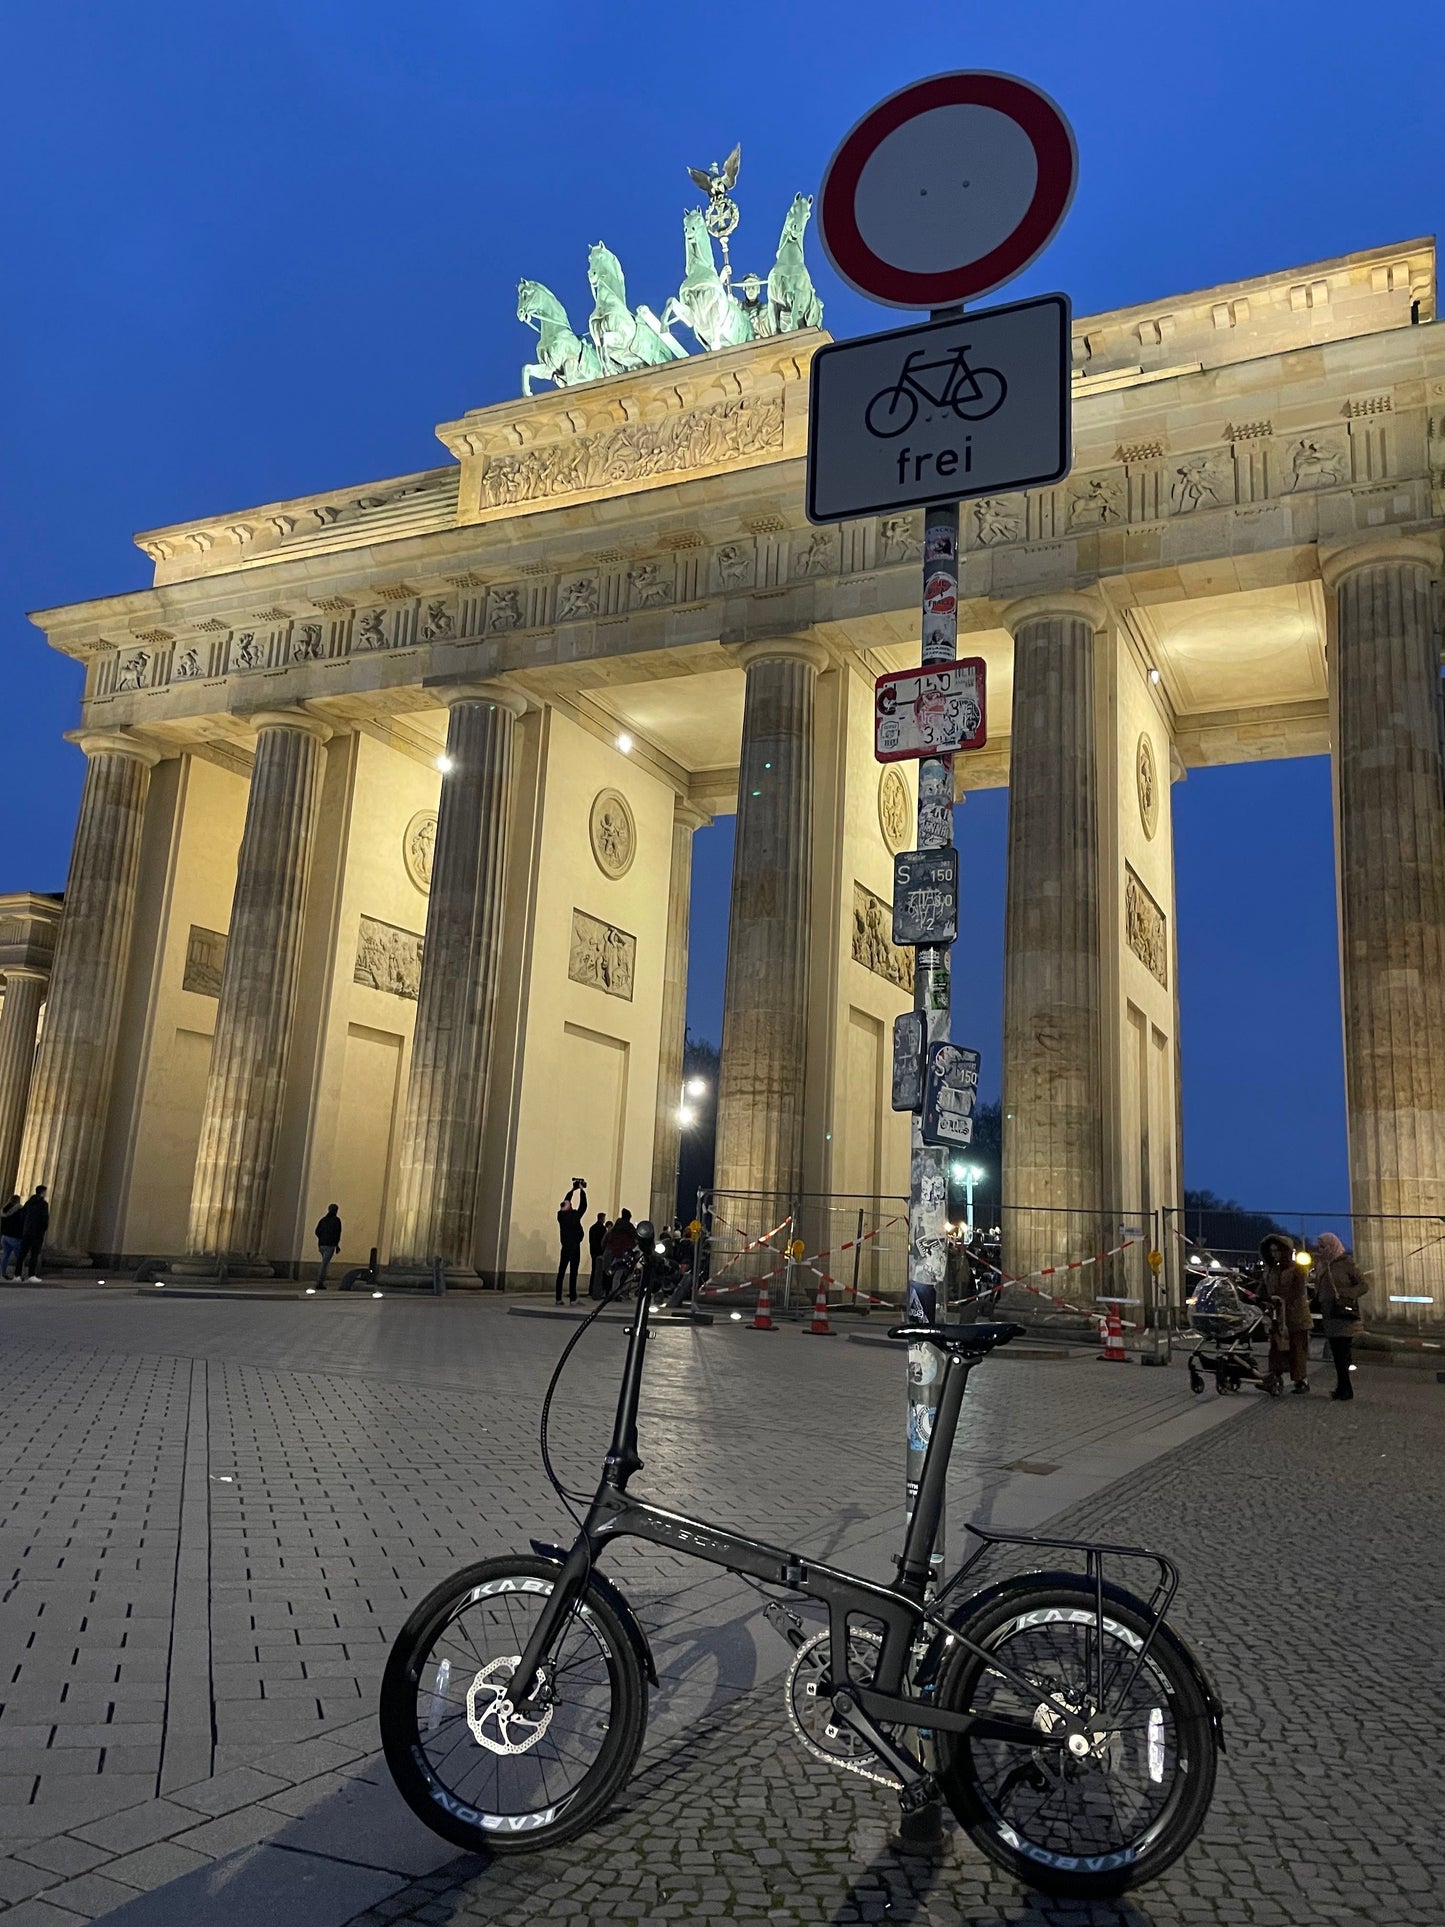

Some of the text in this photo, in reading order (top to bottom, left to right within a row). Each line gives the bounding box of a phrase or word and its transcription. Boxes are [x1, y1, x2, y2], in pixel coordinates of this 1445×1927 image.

[897, 435, 973, 484] frei
[897, 866, 953, 885] S 150
[960, 1069, 977, 1085] 150
[1016, 1609, 1145, 1651] KABON
